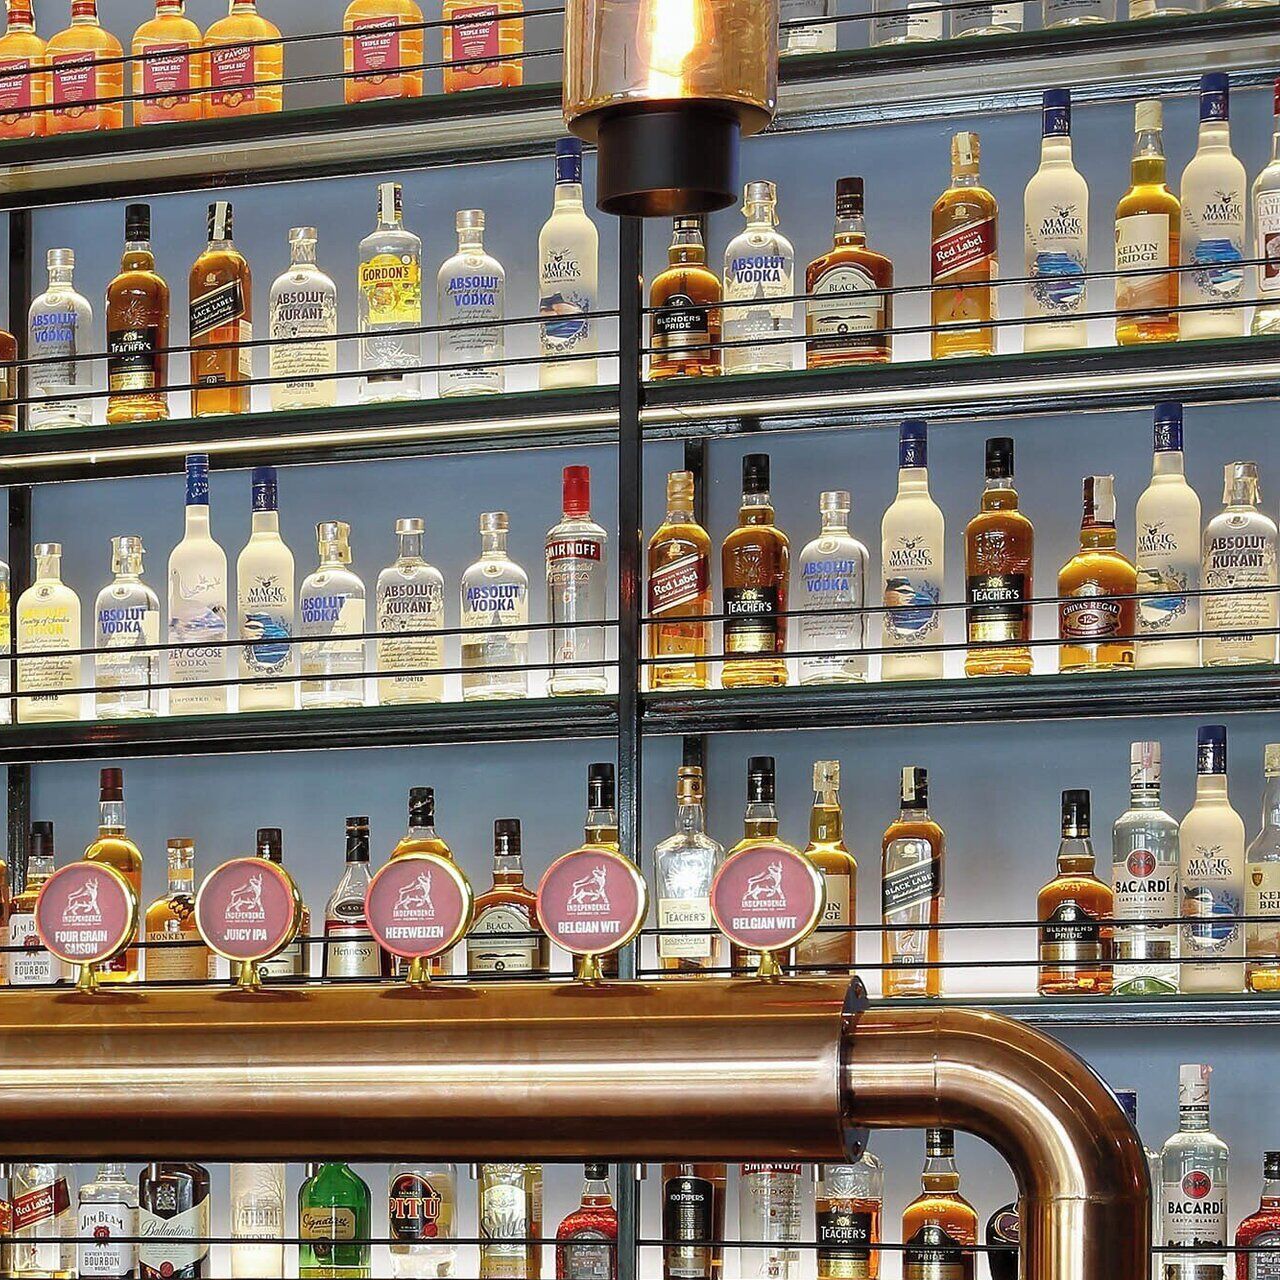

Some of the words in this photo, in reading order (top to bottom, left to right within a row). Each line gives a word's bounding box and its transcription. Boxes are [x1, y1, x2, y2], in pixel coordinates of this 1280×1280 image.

[1206, 203, 1242, 214] MAGIC
[1043, 218, 1082, 229] MAGIC
[935, 246, 953, 260] Red
[953, 236, 984, 252] Label
[1117, 242, 1159, 256] KELVIN
[544, 261, 579, 272] MAGIC
[730, 256, 785, 272] ABSOLUT
[363, 265, 409, 281] GORDON'S
[736, 269, 781, 284] VODKA
[449, 275, 499, 290] ABSOLUT
[828, 282, 860, 292] BLACK
[211, 297, 235, 312] LABEL
[276, 290, 326, 306] ABSOLUT
[454, 293, 495, 306] VODKA
[32, 313, 77, 327] ABSOLUT
[278, 308, 324, 321] KURANT
[664, 322, 691, 330] PRIDE
[35, 330, 74, 342] VODKA
[109, 342, 151, 355] TEACHER'S
[1211, 536, 1265, 552] ABSOLUT
[889, 548, 931, 560] MAGIC
[803, 561, 854, 575] ABSOLUT
[888, 557, 933, 567] MOMENTS
[1212, 554, 1264, 569] KURANT
[653, 582, 672, 596] Red
[672, 571, 699, 590] Label
[807, 579, 849, 593] VODKA
[249, 586, 283, 597] MAGIC
[384, 584, 434, 598] ABSOLUT
[466, 585, 520, 600] ABSOLUT
[971, 587, 1019, 604] TEACHER'S
[386, 601, 433, 614] KURANT
[471, 599, 515, 612] VODKA
[727, 600, 772, 617] TEACHER'S
[1062, 602, 1093, 616] CHIVAS
[1094, 602, 1120, 616] REGAL
[98, 608, 147, 622] ABSOLUT
[302, 609, 339, 623] VODKA
[1083, 615, 1094, 624] 12
[101, 621, 141, 634] VODKA
[1188, 857, 1230, 870] MAGIC
[1186, 866, 1233, 876] MOMENTS
[884, 880, 911, 897] BLACK
[1115, 876, 1171, 894] BACARDÍ
[566, 903, 611, 912] INDEPENDENCE
[741, 899, 787, 908] INDEPENDENCE
[62, 915, 103, 923] INDEPENDENCE
[224, 911, 265, 919] INDEPENDENCE
[393, 909, 435, 918] INDEPENDENCE
[664, 909, 706, 924] TEACHER'S
[486, 921, 514, 931] BLACK
[558, 920, 597, 934] BELGIAN
[597, 919, 621, 933] WIT
[732, 916, 775, 931] BELGIAN
[775, 915, 797, 930] WIT
[55, 930, 79, 943] FOUR
[79, 929, 108, 943] GRAIN
[150, 932, 187, 942] MONKEY
[223, 929, 251, 942] JUICY
[252, 928, 267, 941] IPA
[385, 926, 444, 939] HEFEWEIZEN
[1054, 931, 1083, 940] PRIDE
[65, 942, 98, 954] SAISON
[332, 945, 373, 958] Hennessy
[14, 966, 49, 976] BOURBON
[681, 1192, 704, 1202] PIPERS
[14, 1205, 30, 1218] Red
[30, 1195, 53, 1210] Label
[1167, 1198, 1224, 1215] BACARDÍ
[81, 1212, 98, 1231] JIM
[98, 1210, 123, 1231] BEAM
[140, 1220, 195, 1237] Ballantine's
[821, 1226, 867, 1241] TEACHER'S
[84, 1256, 120, 1267] BOURBON
[917, 1252, 945, 1261] PRIDE
